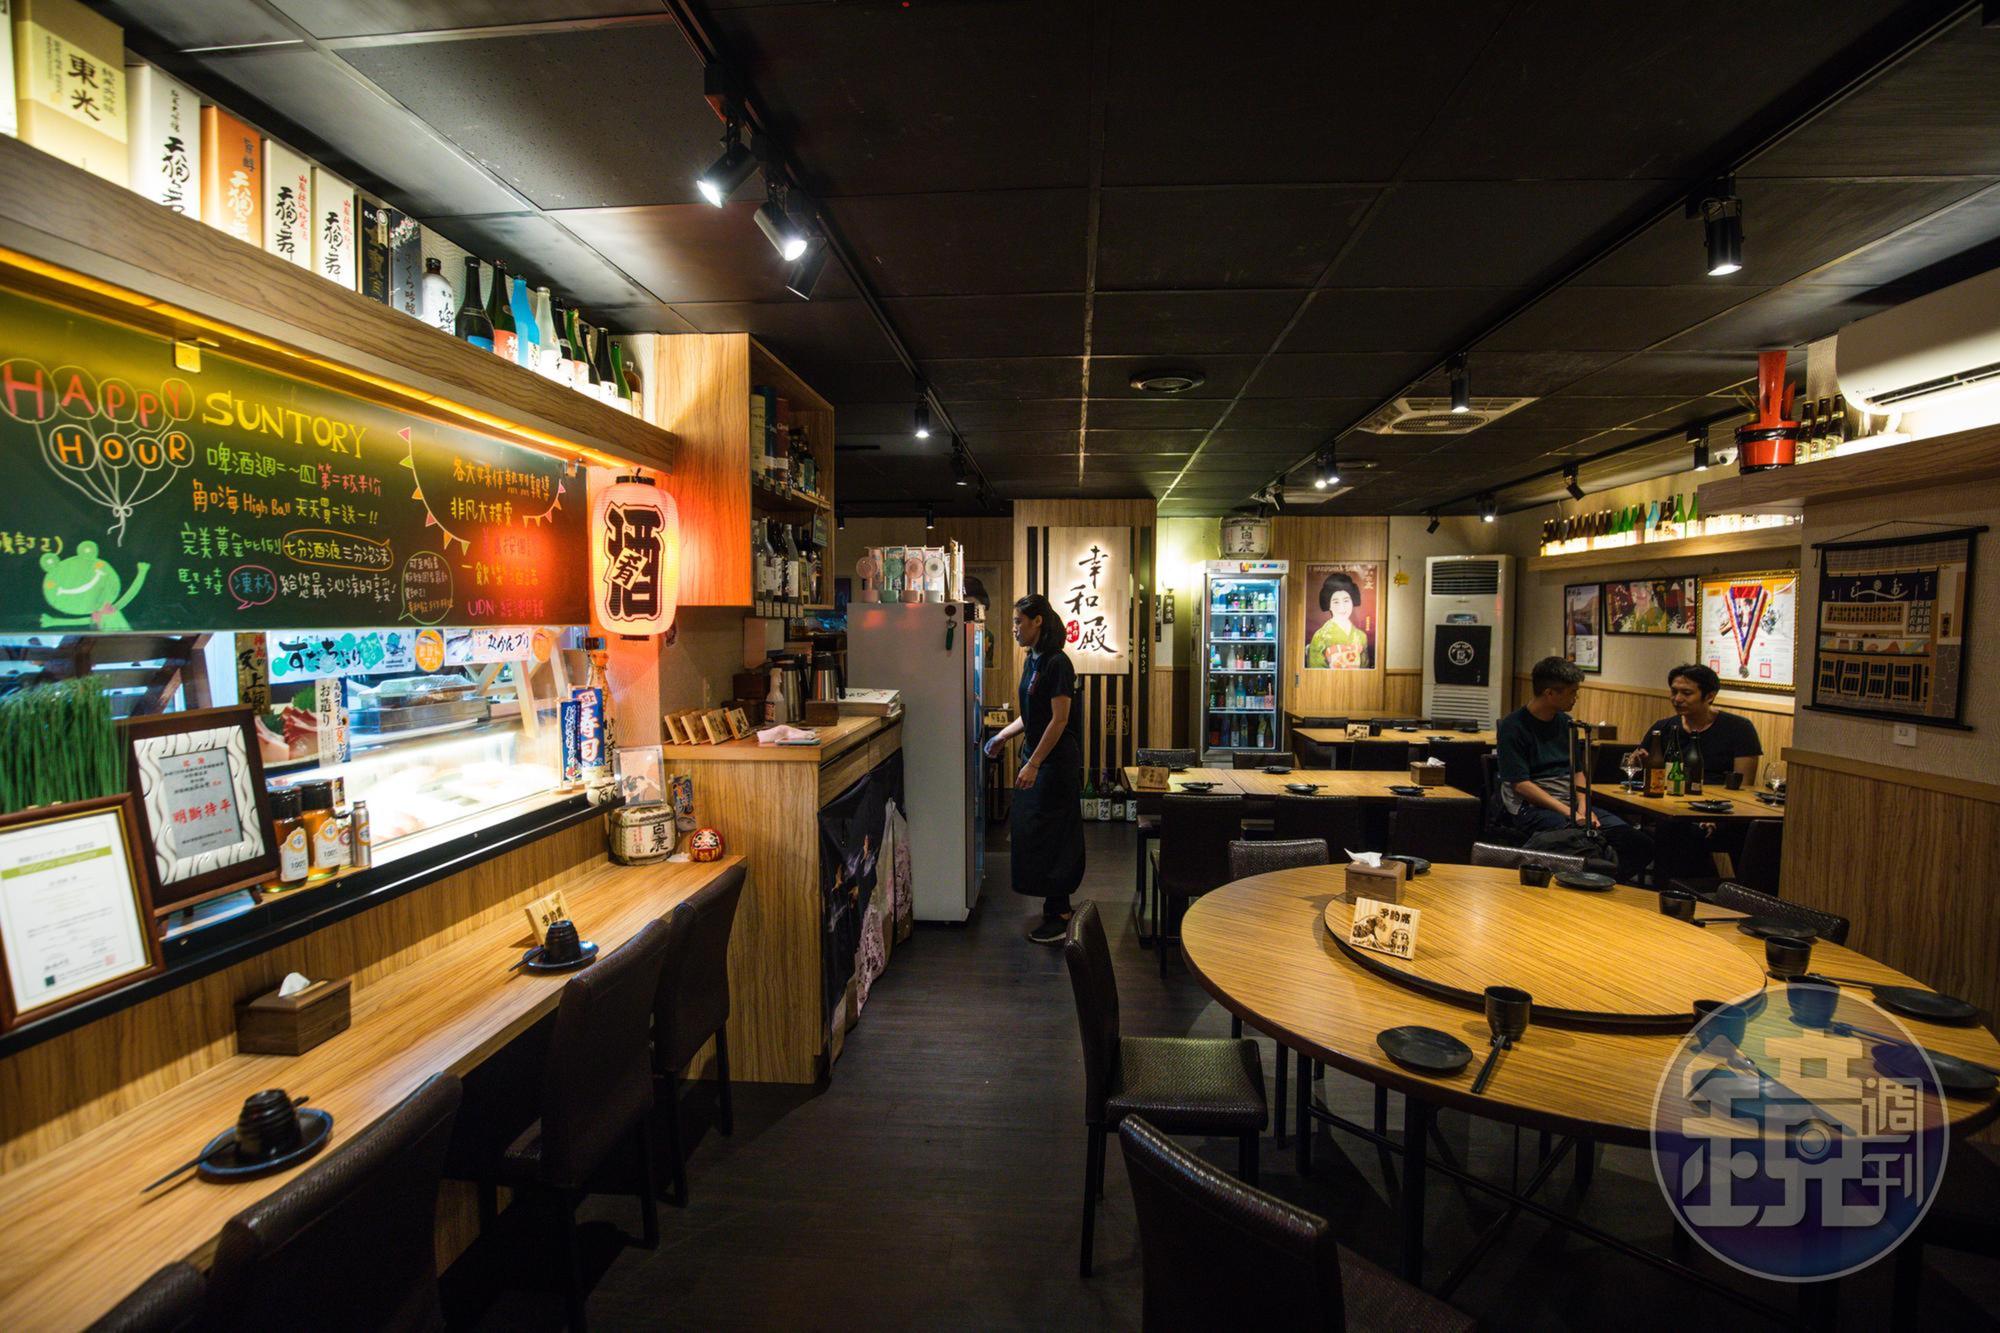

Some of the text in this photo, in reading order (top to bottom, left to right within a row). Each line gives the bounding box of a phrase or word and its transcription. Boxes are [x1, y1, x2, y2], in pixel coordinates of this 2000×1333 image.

[68, 53, 101, 122] 東光
[3, 362, 184, 428] HAPPY
[203, 391, 366, 459] SUNTORY
[56, 431, 187, 466] HOUR
[243, 494, 268, 519] High
[271, 499, 291, 516] Ball
[467, 599, 495, 617] UDN
[1064, 545, 1118, 654] 幸和殿
